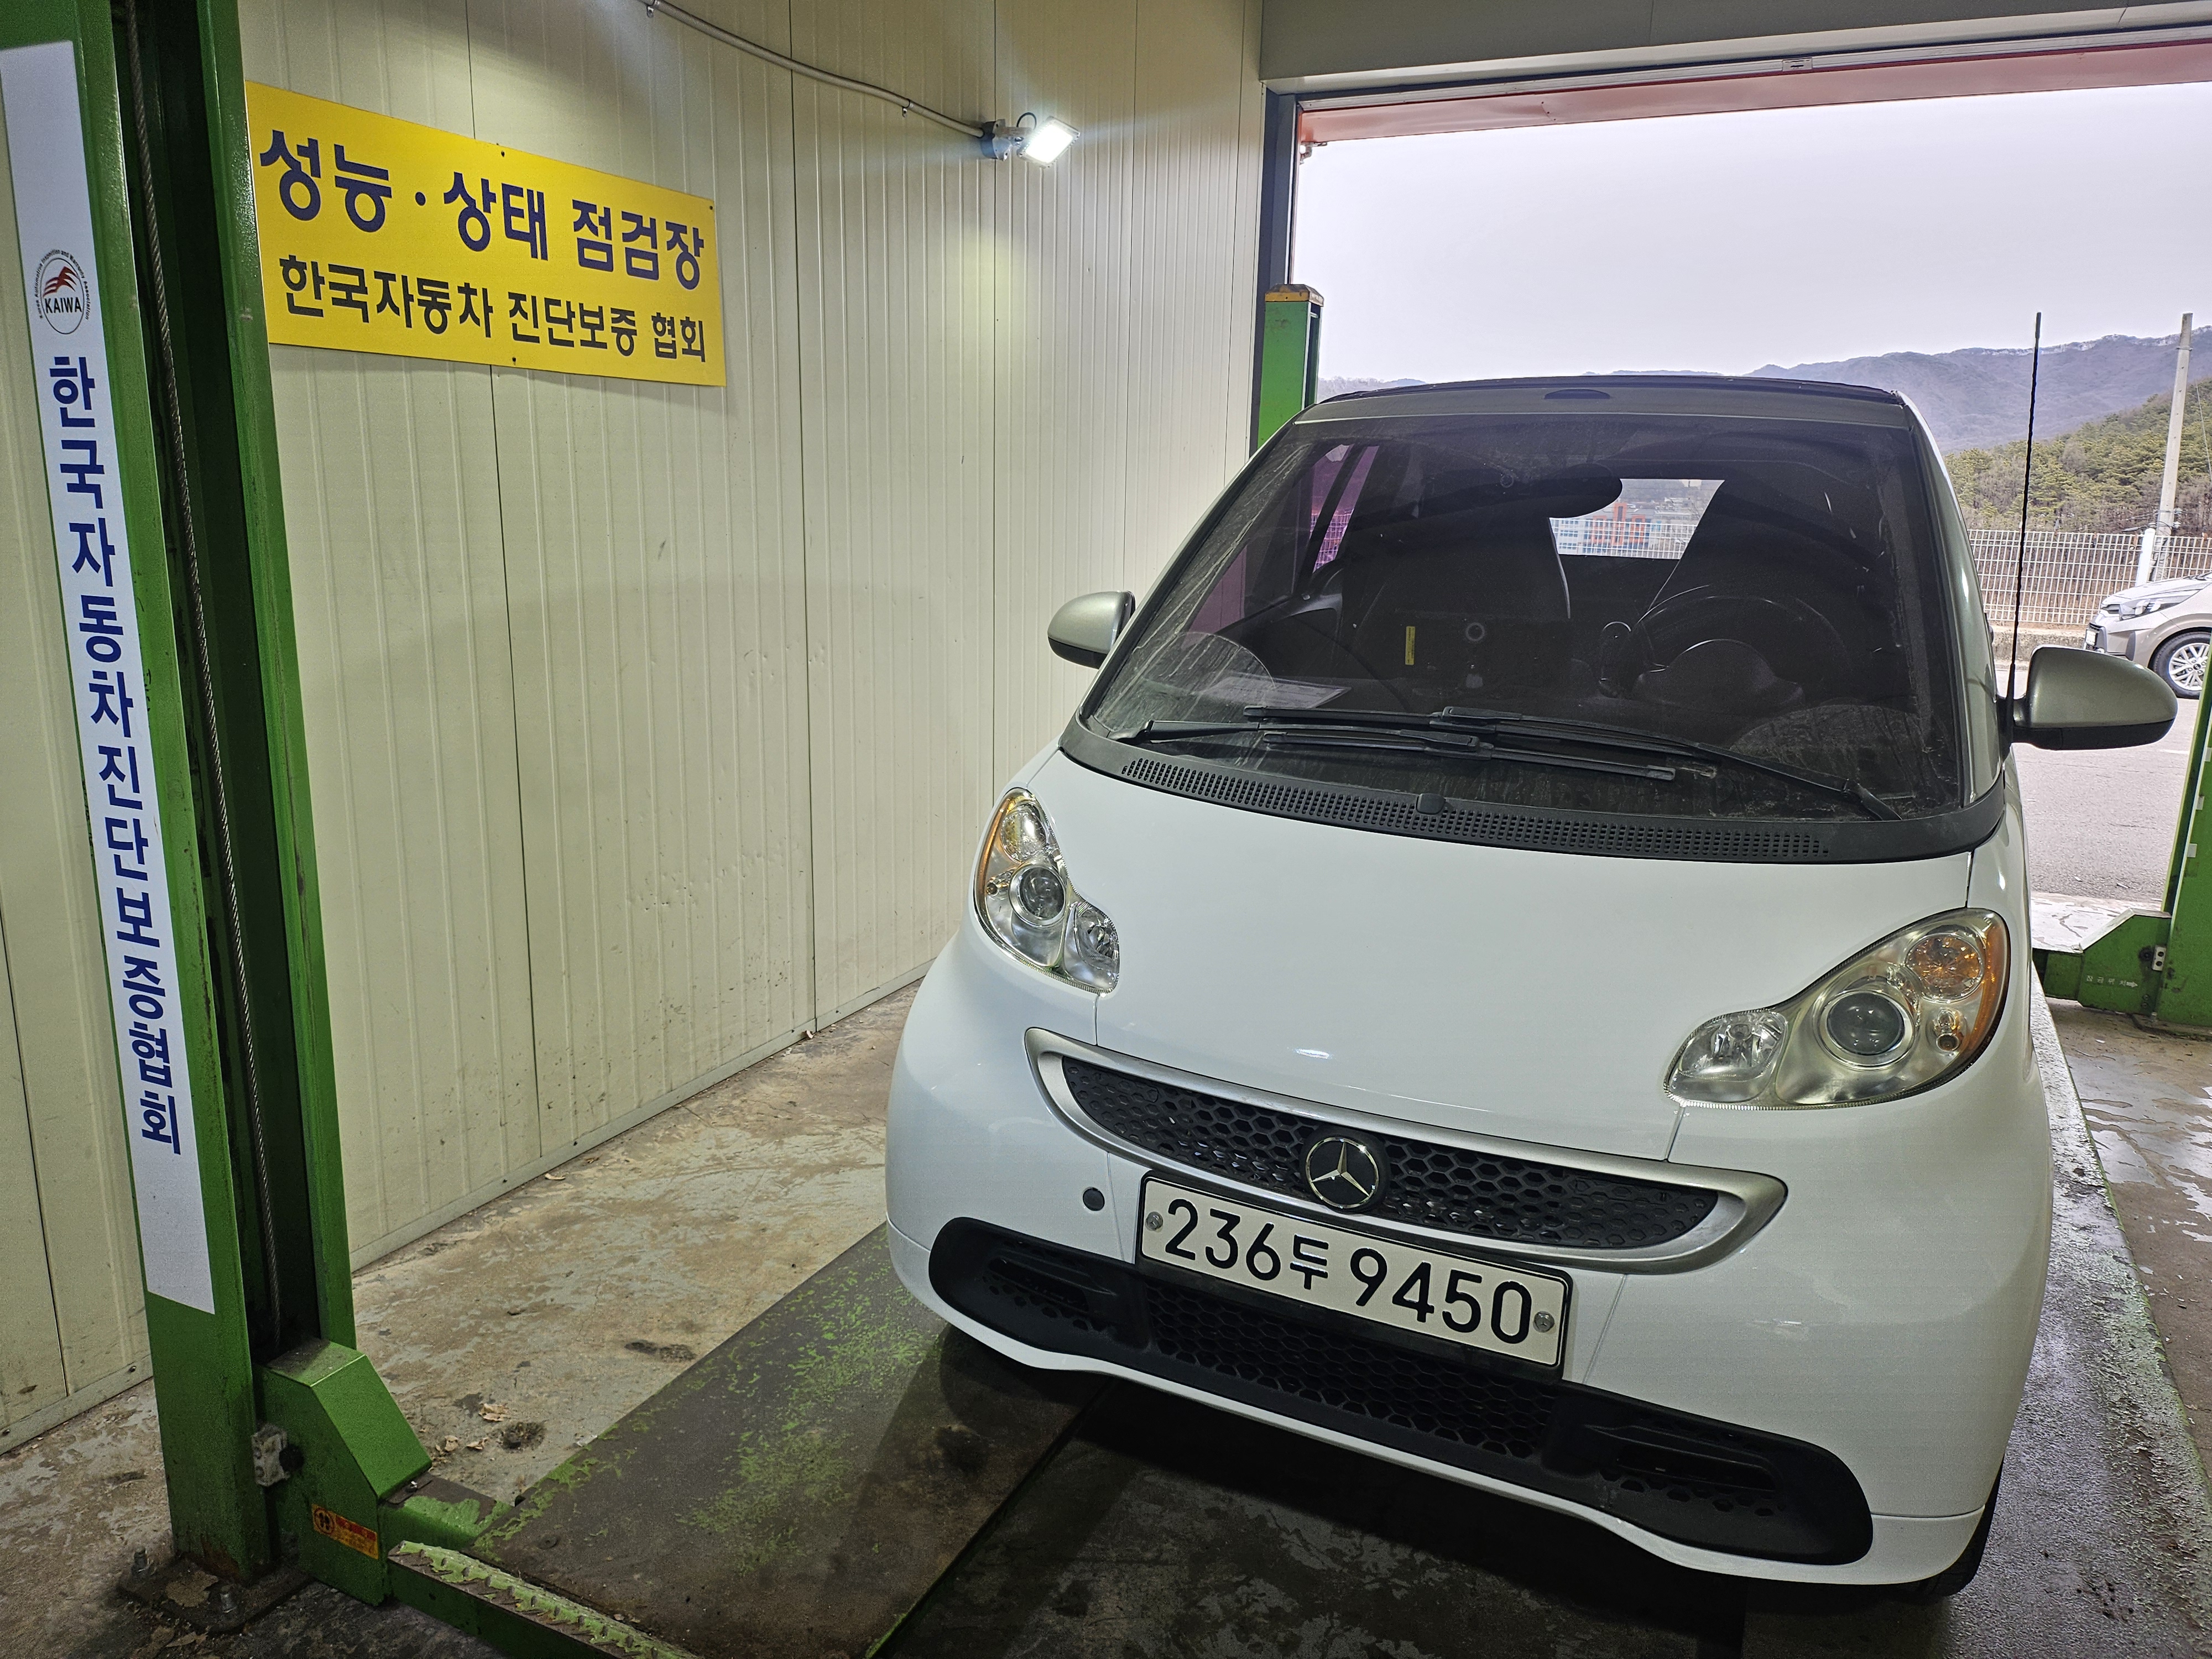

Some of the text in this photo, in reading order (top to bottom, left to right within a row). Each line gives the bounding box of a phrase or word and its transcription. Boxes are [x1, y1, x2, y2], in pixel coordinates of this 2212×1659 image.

[572, 199, 705, 290] 점검장
[44, 297, 82, 314] KAIWA
[279, 254, 706, 363] 한국자동차 진단보증 협회
[1165, 1198, 1532, 1344] 236두 9450
